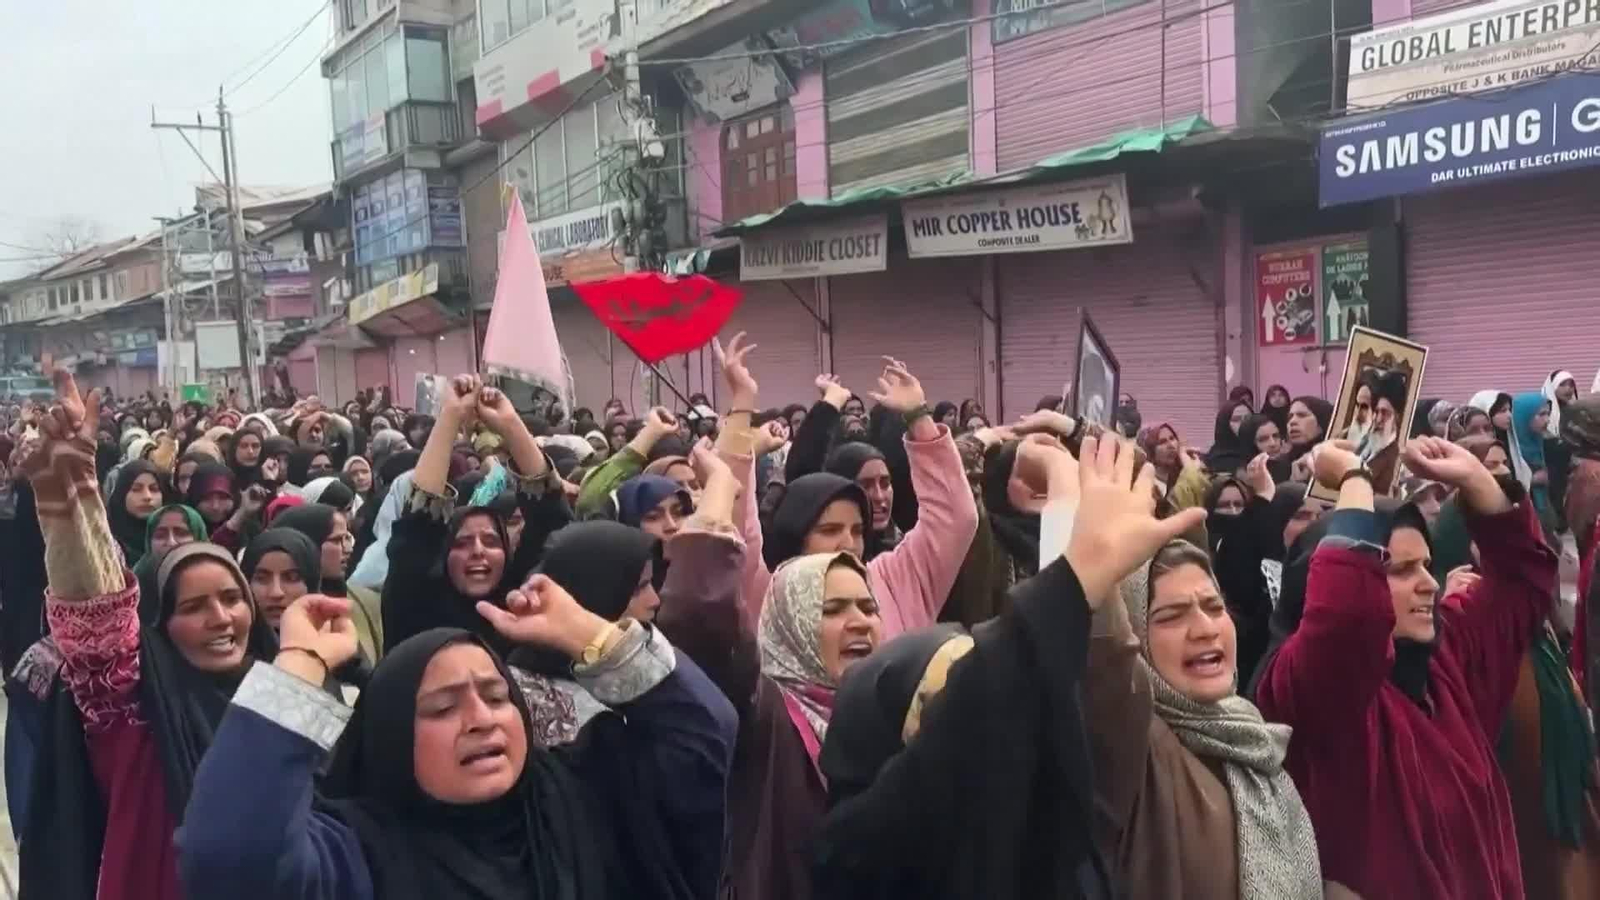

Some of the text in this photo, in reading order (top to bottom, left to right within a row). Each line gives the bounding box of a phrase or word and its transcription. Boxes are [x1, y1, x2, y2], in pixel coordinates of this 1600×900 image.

[1361, 28, 1456, 71] GLOBAL
[1444, 41, 1566, 74] Pharmaceutical Distributors
[1406, 81, 1468, 101] OPPOSITE
[1472, 79, 1479, 89] J
[1484, 75, 1493, 87] &
[1498, 73, 1507, 84] K
[1511, 64, 1552, 81] BANK
[1335, 108, 1541, 178] SAMSUNG
[1431, 170, 1454, 183] DAR
[1457, 160, 1517, 178] ULTIMATE
[566, 214, 608, 247] LABORATORY
[912, 201, 1082, 238] MIR COPPER HOUSE
[782, 239, 825, 265] KIDDIE
[828, 232, 882, 261] CLOSET
[977, 234, 1041, 248] COMPOSITE DEALER
